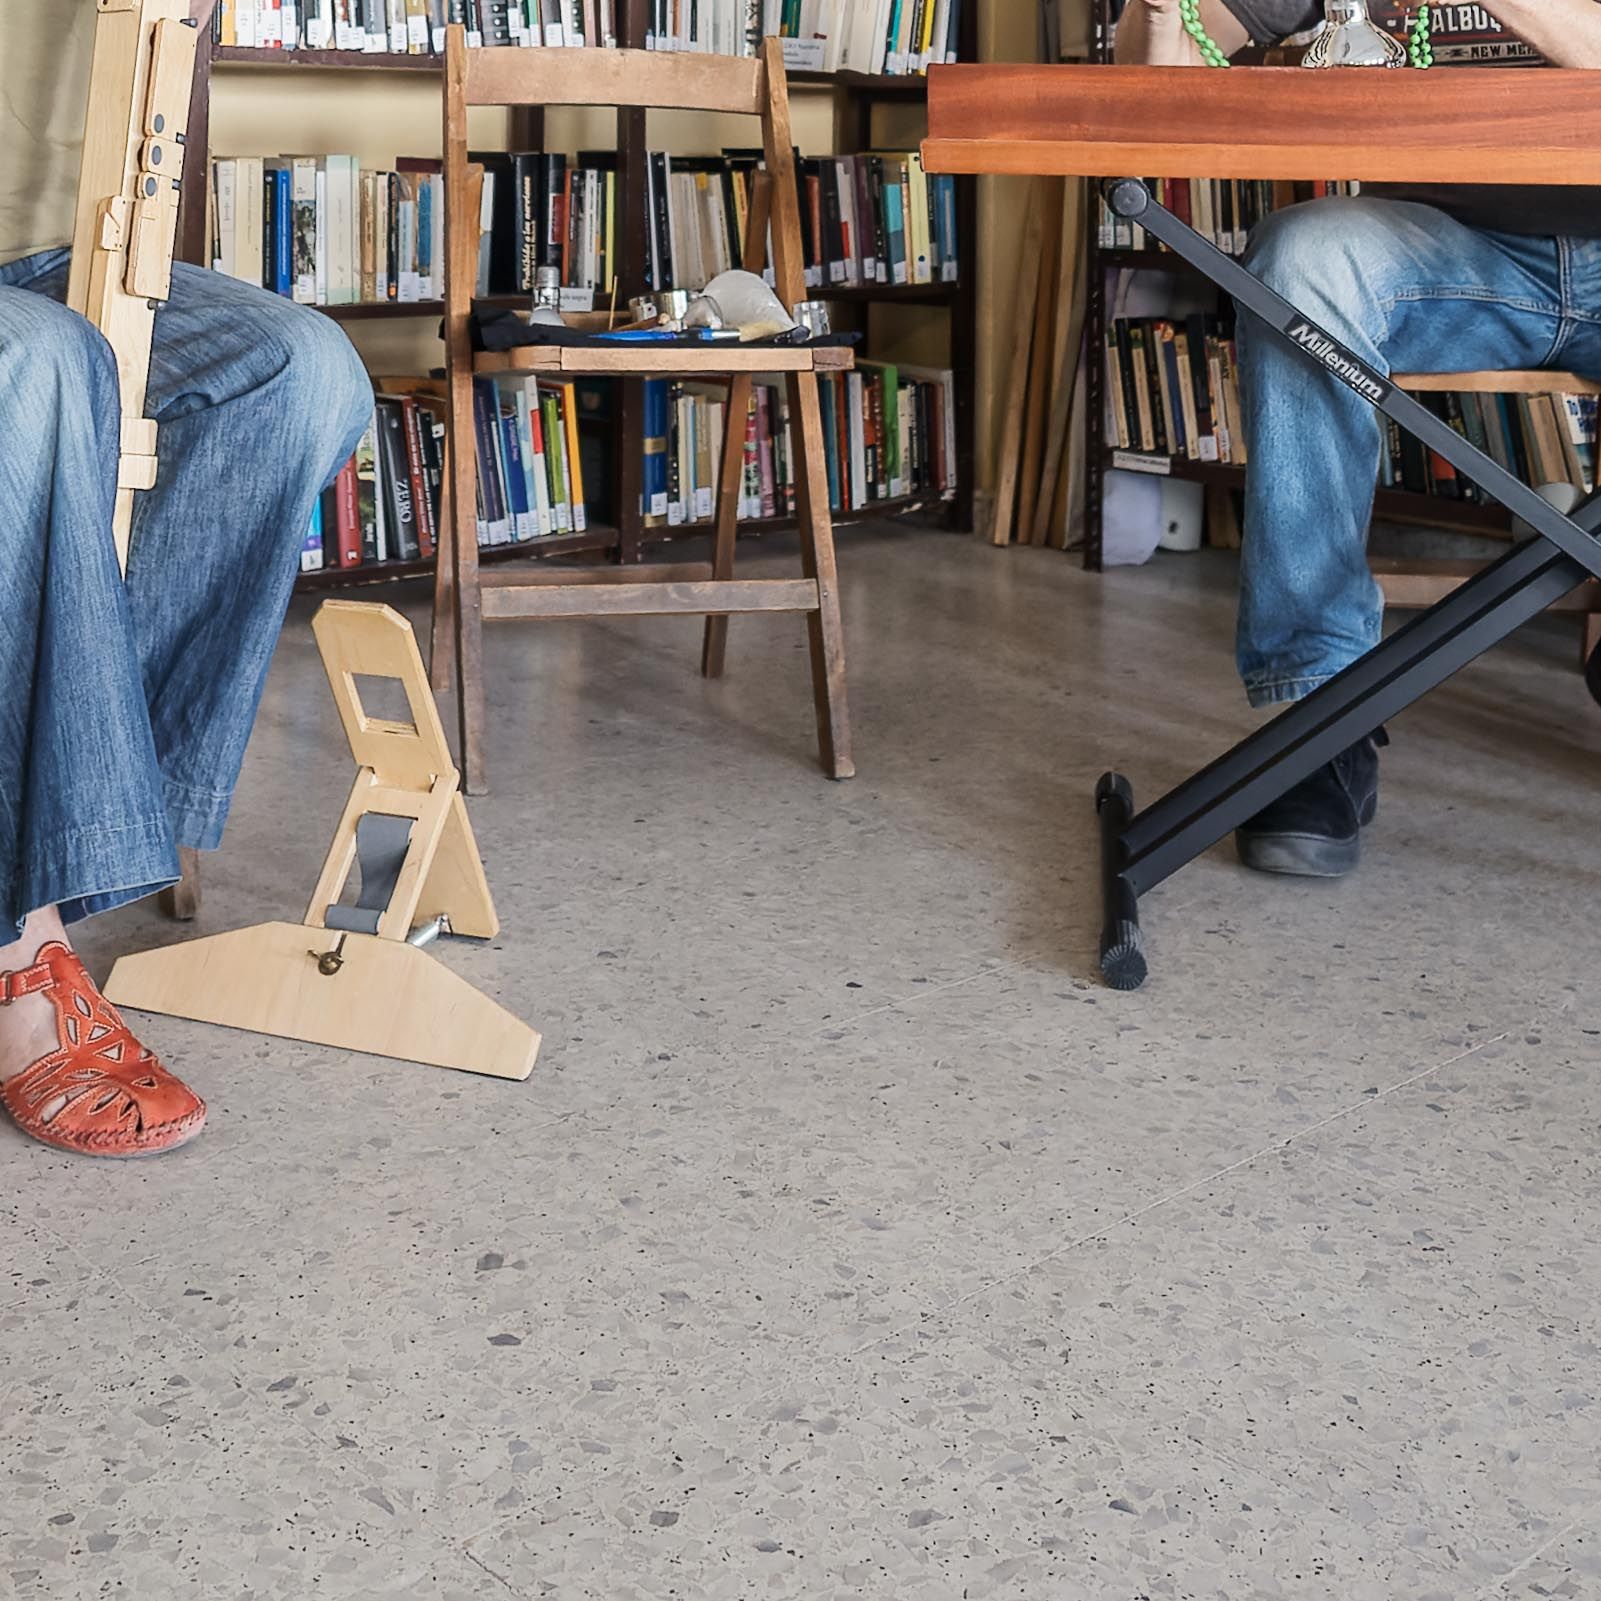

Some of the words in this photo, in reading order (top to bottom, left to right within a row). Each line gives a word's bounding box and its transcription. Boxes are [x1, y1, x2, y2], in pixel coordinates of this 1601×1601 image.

[1471, 44, 1503, 57] NEW
[1290, 324, 1387, 401] Millenium
[394, 480, 413, 523] ZERO
